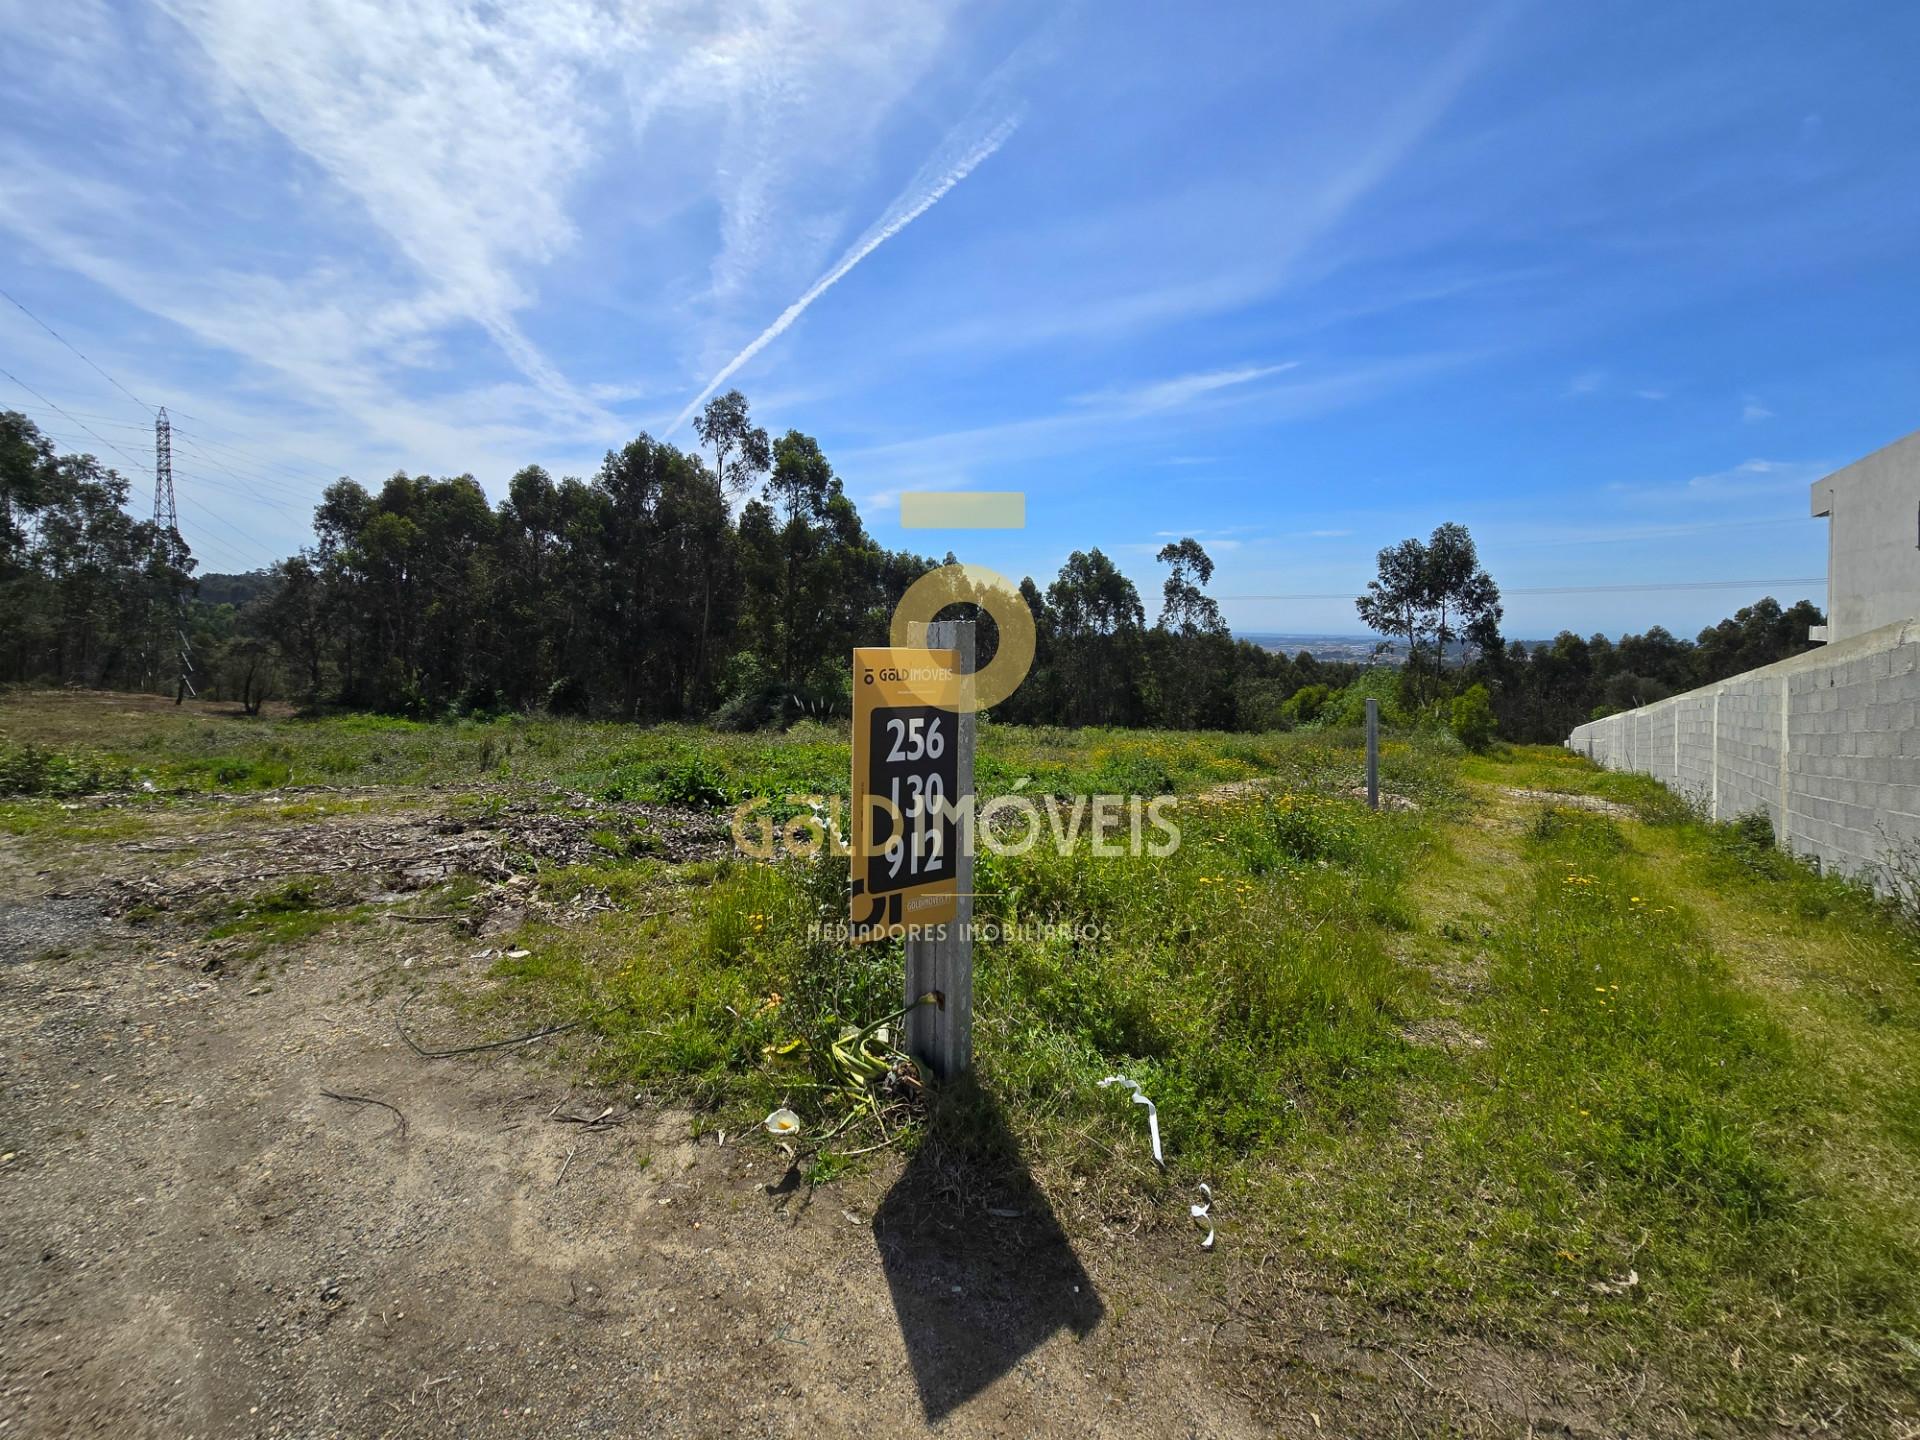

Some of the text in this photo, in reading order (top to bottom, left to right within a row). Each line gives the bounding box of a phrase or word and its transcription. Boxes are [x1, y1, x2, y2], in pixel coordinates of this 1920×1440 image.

[886, 716, 945, 763] 256
[891, 771, 944, 820] 130
[885, 828, 943, 880] 912
